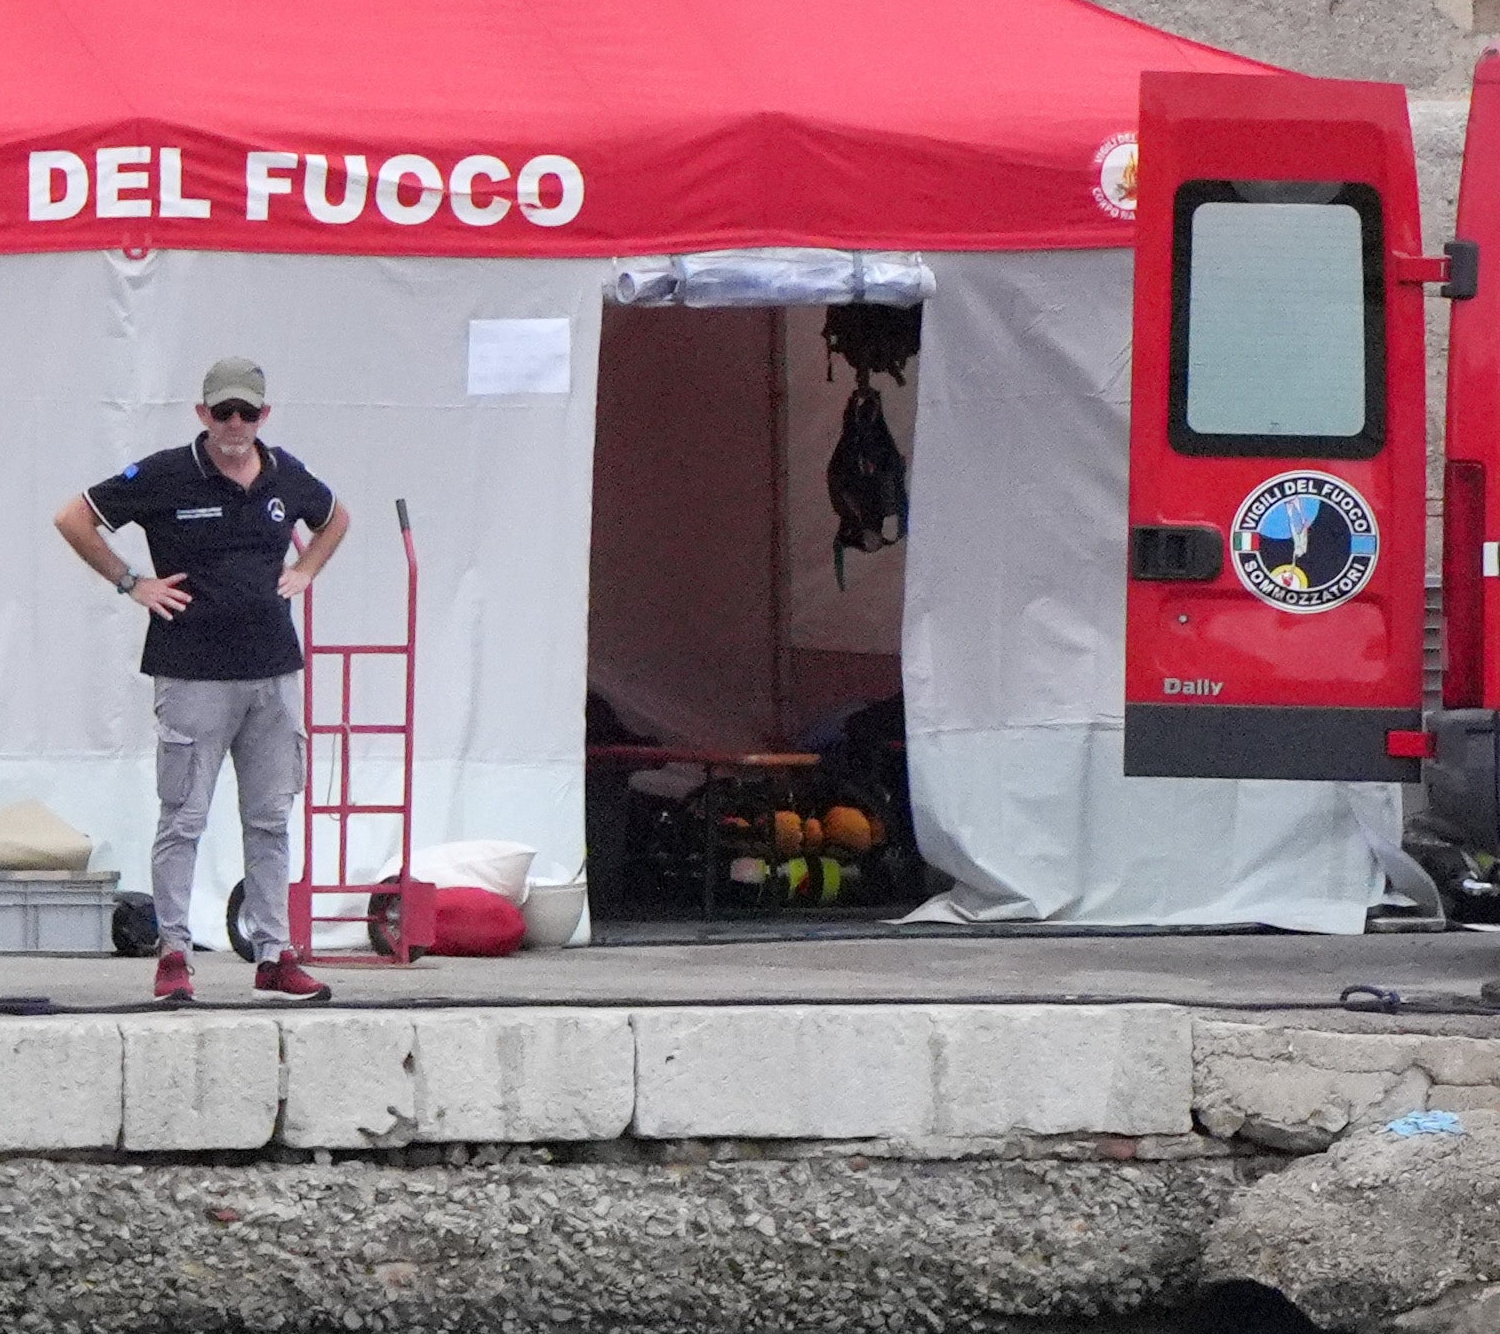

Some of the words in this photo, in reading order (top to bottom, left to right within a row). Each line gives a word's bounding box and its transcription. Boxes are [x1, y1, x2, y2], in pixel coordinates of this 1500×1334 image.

[29, 147, 210, 220] DEL
[247, 152, 583, 226] FUOCO
[1242, 488, 1282, 530] VIGILI
[1284, 478, 1318, 495] DEL
[1321, 483, 1368, 533] FUOCO
[1242, 559, 1367, 606] SOMMOZZATORI
[1163, 678, 1224, 697] Daily
